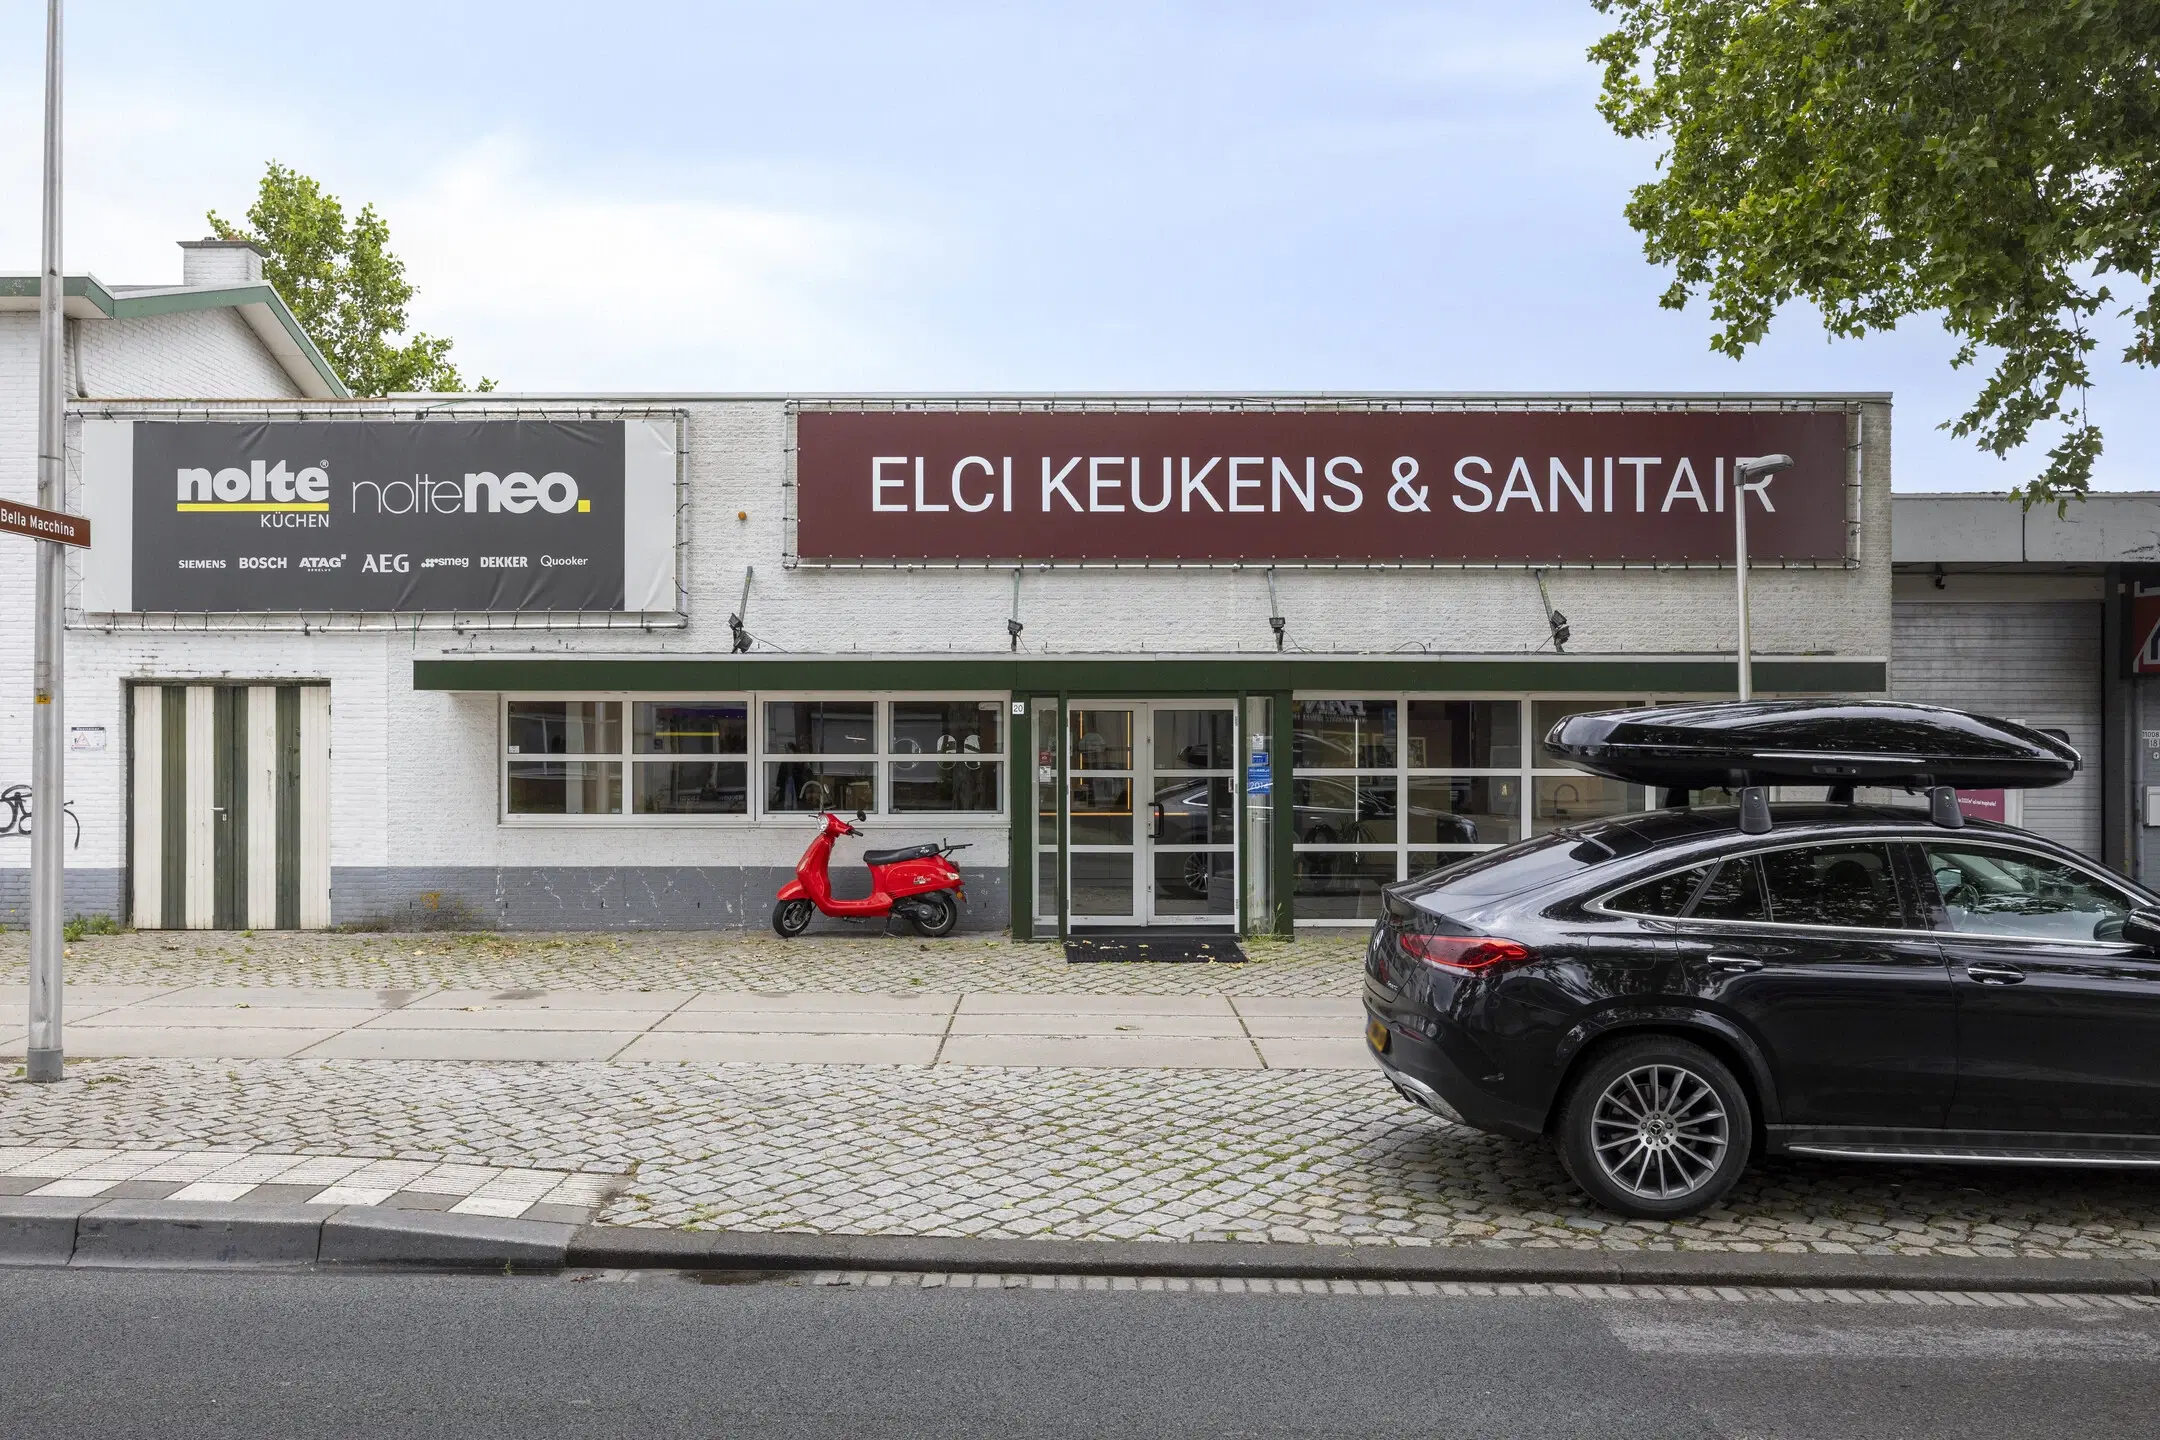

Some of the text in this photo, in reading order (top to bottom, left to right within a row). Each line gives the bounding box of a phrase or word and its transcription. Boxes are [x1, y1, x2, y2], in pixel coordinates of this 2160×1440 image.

[177, 459, 330, 503] nolte
[872, 455, 1776, 513] ELCI KEUKENS & SANITAIR
[0, 508, 75, 537] Bella Macchina
[260, 510, 330, 528] KÜCHEN
[178, 553, 588, 573] SIEMENS BOSCH ATAG AEG smeg DEKKER Quooker
[1013, 704, 1023, 712] 20
[2150, 739, 2158, 747] 18
